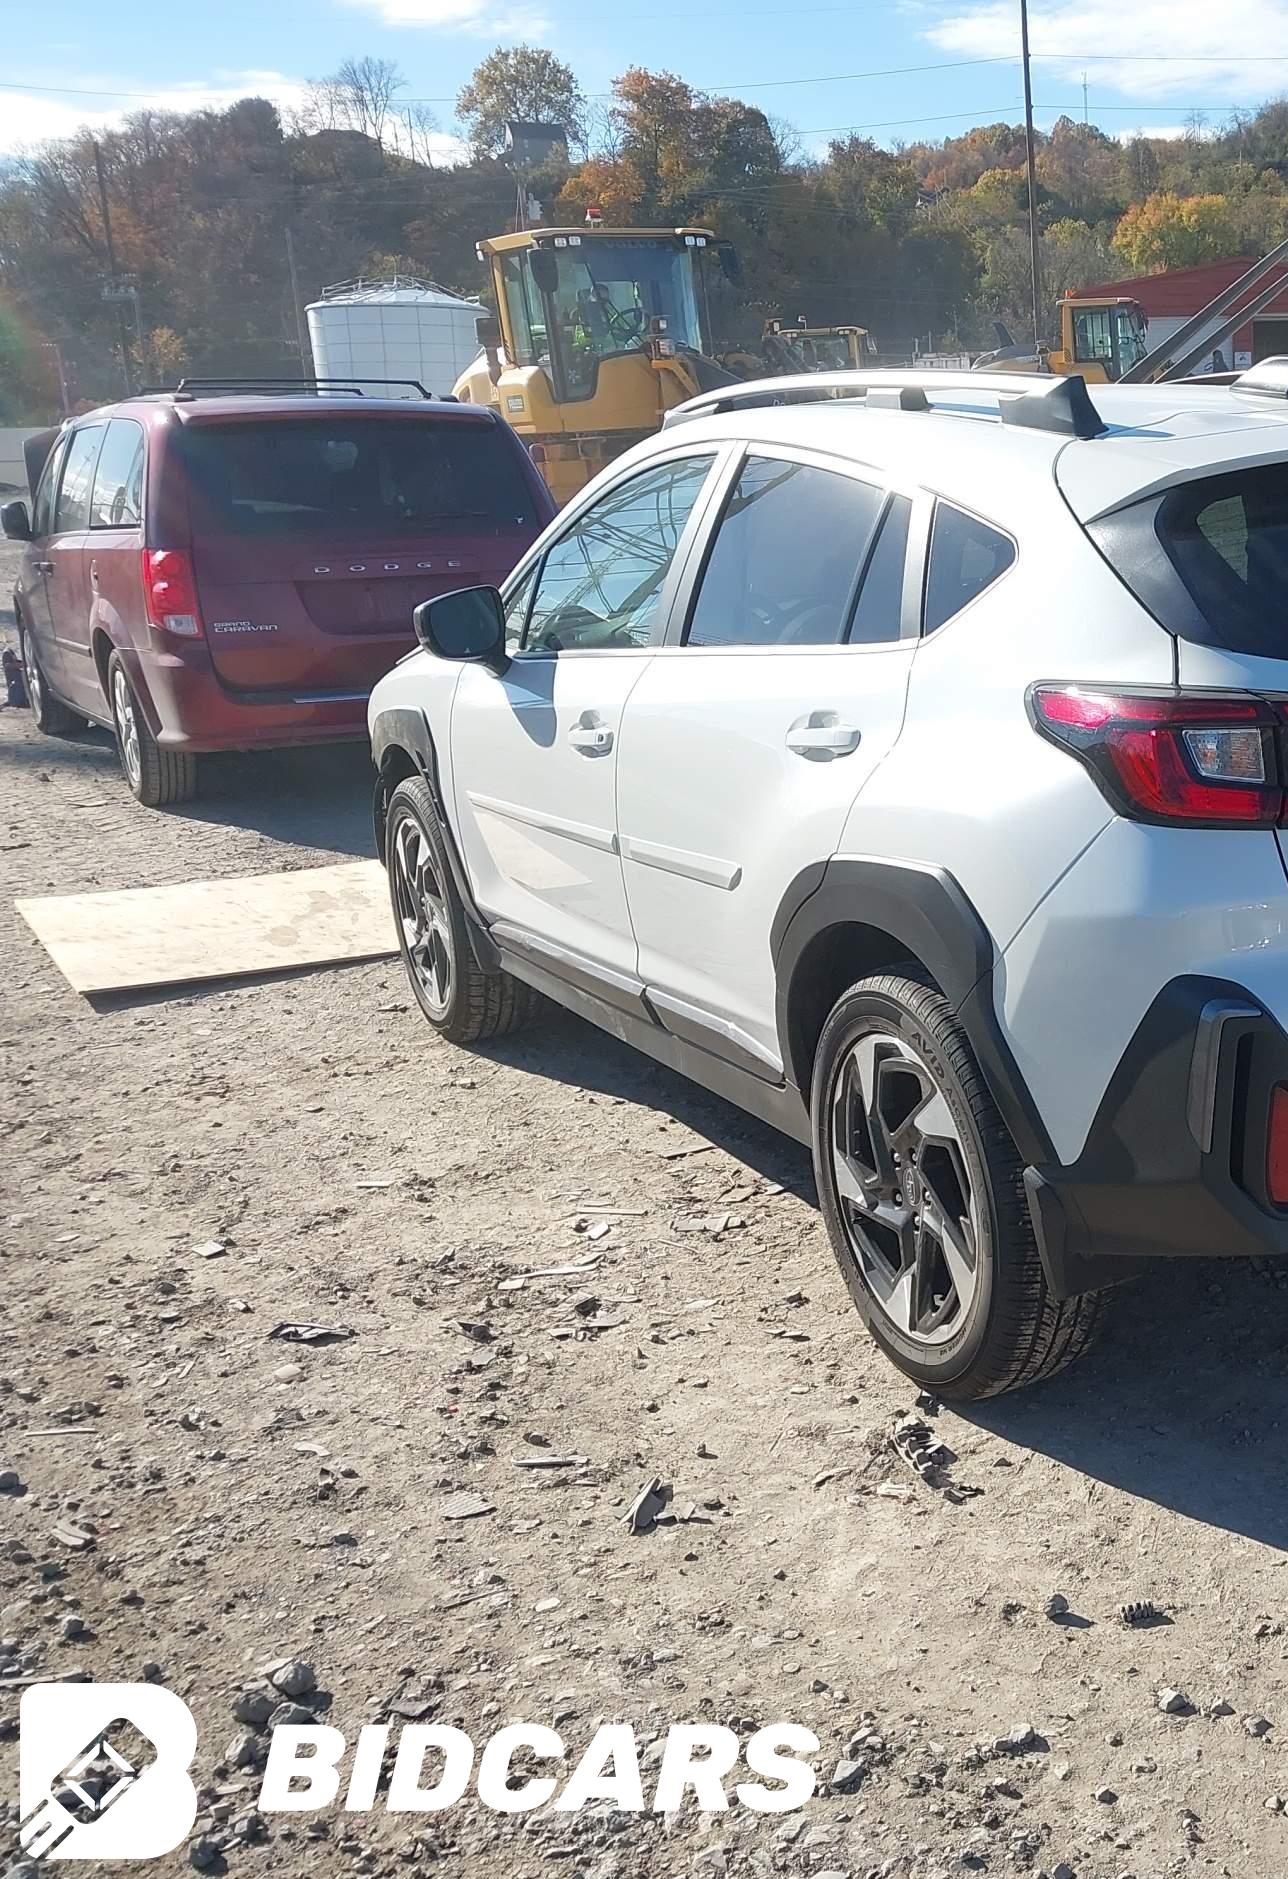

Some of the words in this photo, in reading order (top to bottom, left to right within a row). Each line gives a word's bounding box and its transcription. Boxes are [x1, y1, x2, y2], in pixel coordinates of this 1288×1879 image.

[314, 560, 462, 574] DODGE
[214, 624, 278, 633] CARAVAN
[911, 1031, 945, 1079] AVID
